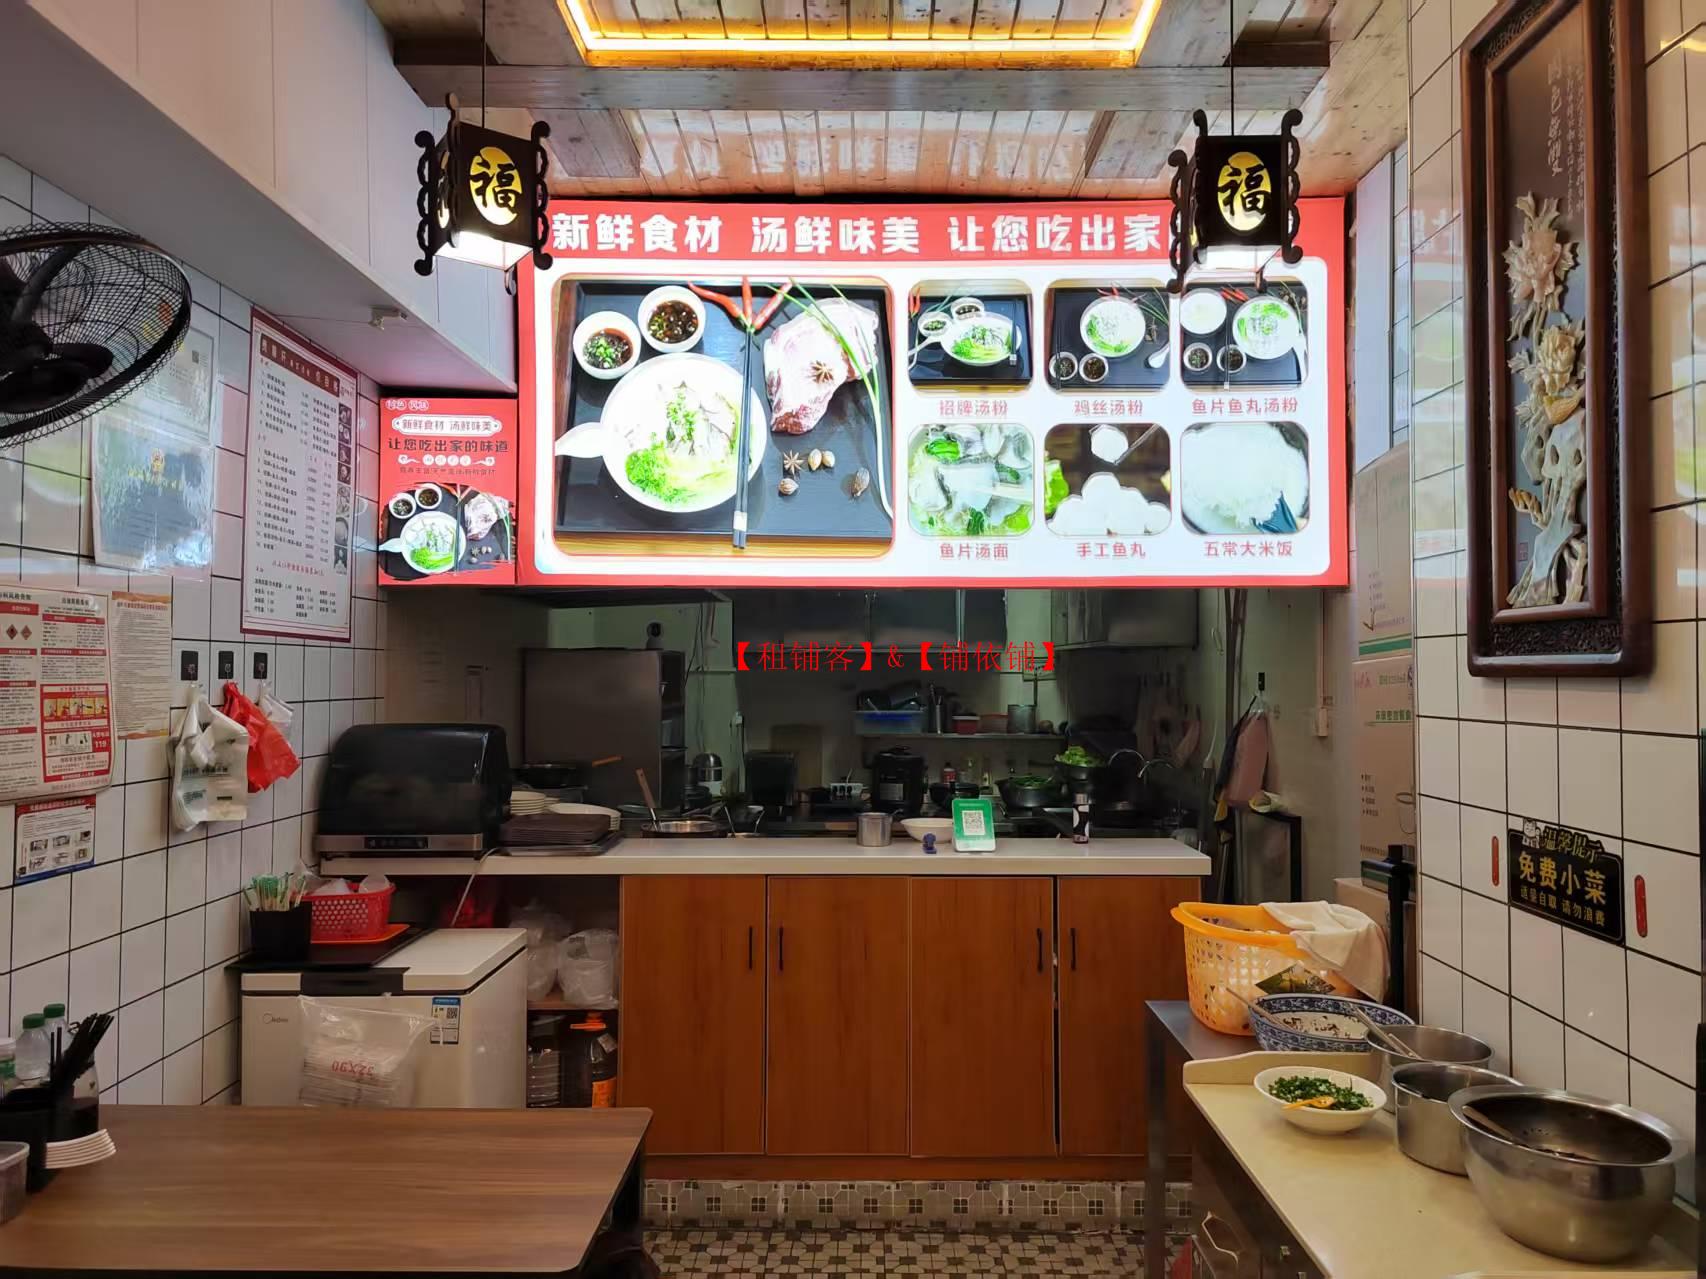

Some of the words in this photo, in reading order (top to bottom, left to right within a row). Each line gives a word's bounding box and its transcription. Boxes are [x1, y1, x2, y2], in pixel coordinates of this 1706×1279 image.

[470, 147, 523, 226] 福
[1217, 151, 1272, 232] 福
[552, 213, 722, 253] 新鲜食材
[751, 215, 920, 254] 汤鲜味美
[947, 213, 1174, 255] 让您吃出家
[939, 400, 1009, 417] 招牌汤粉
[1074, 400, 1144, 417] 鸡丝汤粉
[1191, 398, 1299, 416] 鱼片鱼丸汤粉
[402, 419, 444, 431] 新鲜食材
[449, 420, 492, 432] 汤鲜味美
[388, 438, 508, 453] 让您吃出家的味道
[939, 542, 1009, 560] 鱼片汤面
[1075, 541, 1147, 558] 手工鱼丸
[1203, 540, 1294, 558] 五常大米饭
[1518, 851, 1606, 905] 免费小菜
